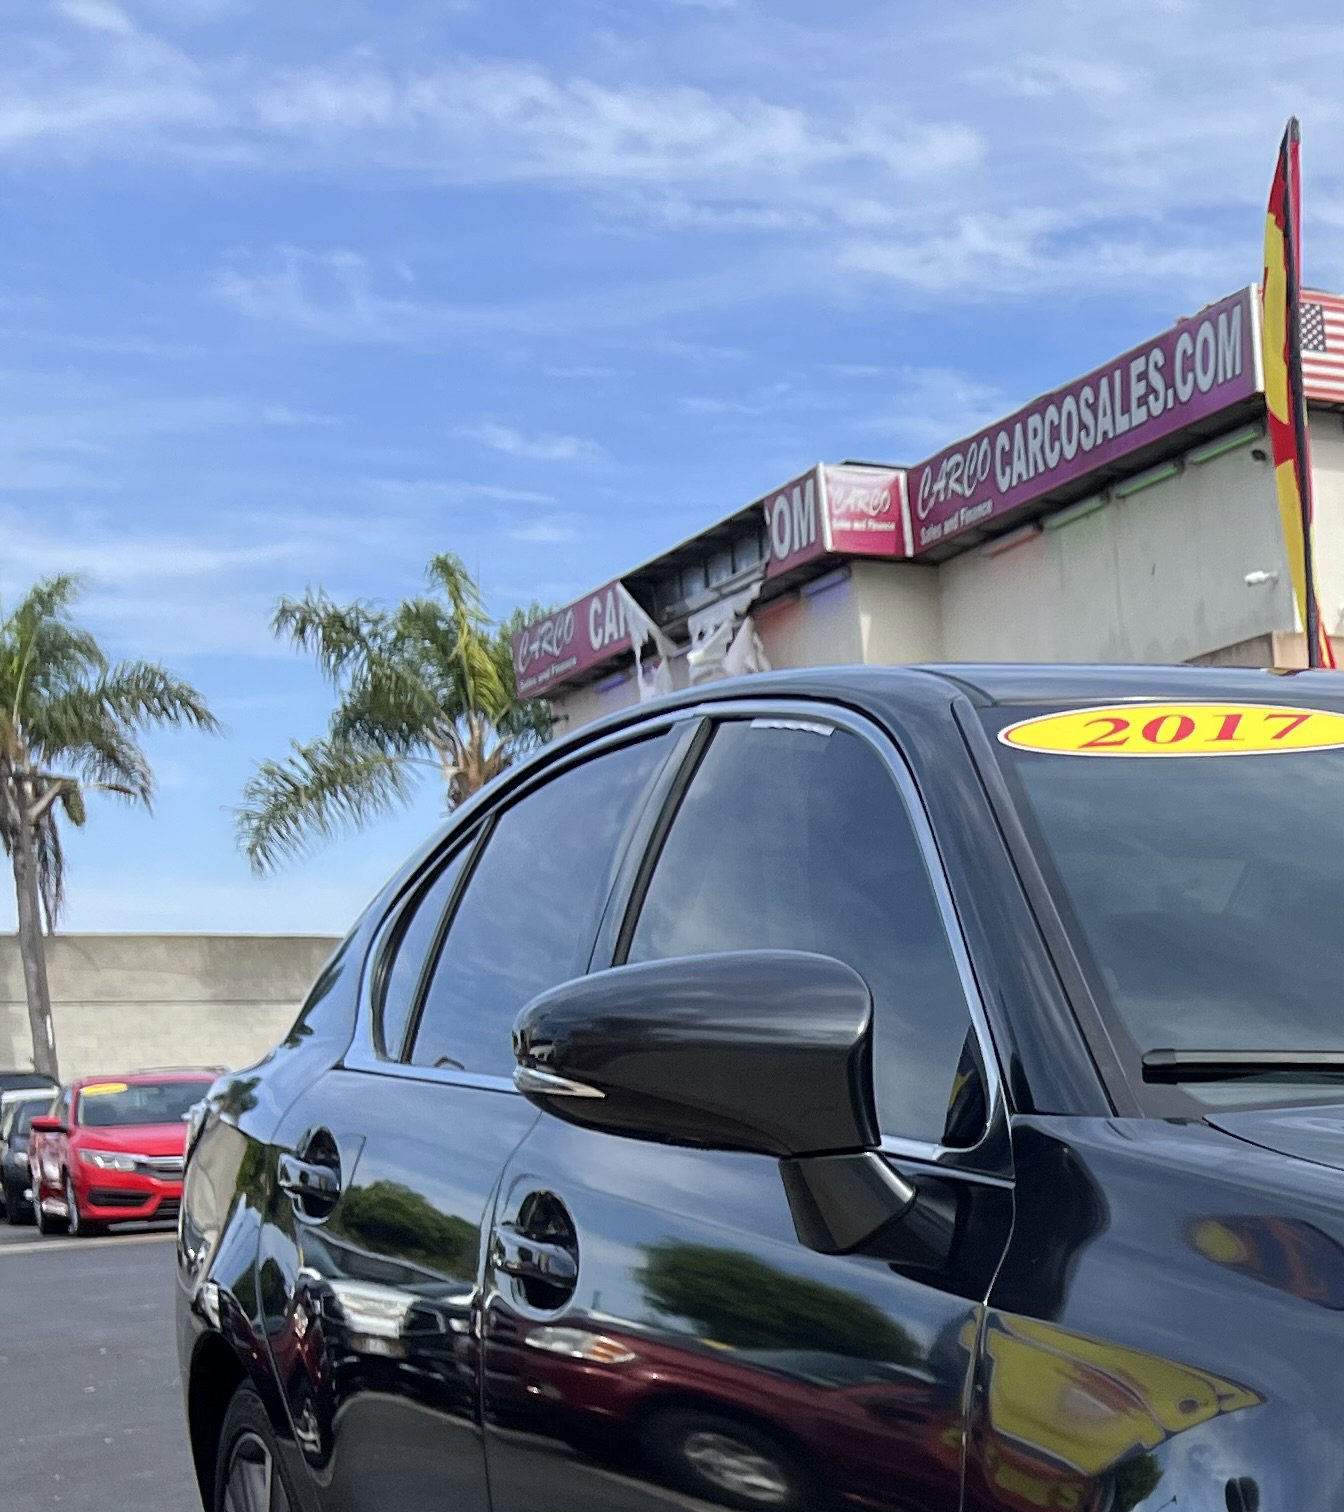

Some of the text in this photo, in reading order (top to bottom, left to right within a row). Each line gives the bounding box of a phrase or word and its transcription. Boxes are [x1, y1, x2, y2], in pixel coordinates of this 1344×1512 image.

[917, 304, 1243, 520] CARCO CARCOSALES.COM
[764, 479, 816, 561] OM
[518, 608, 575, 674] CARCO
[1077, 712, 1313, 750] 2017
